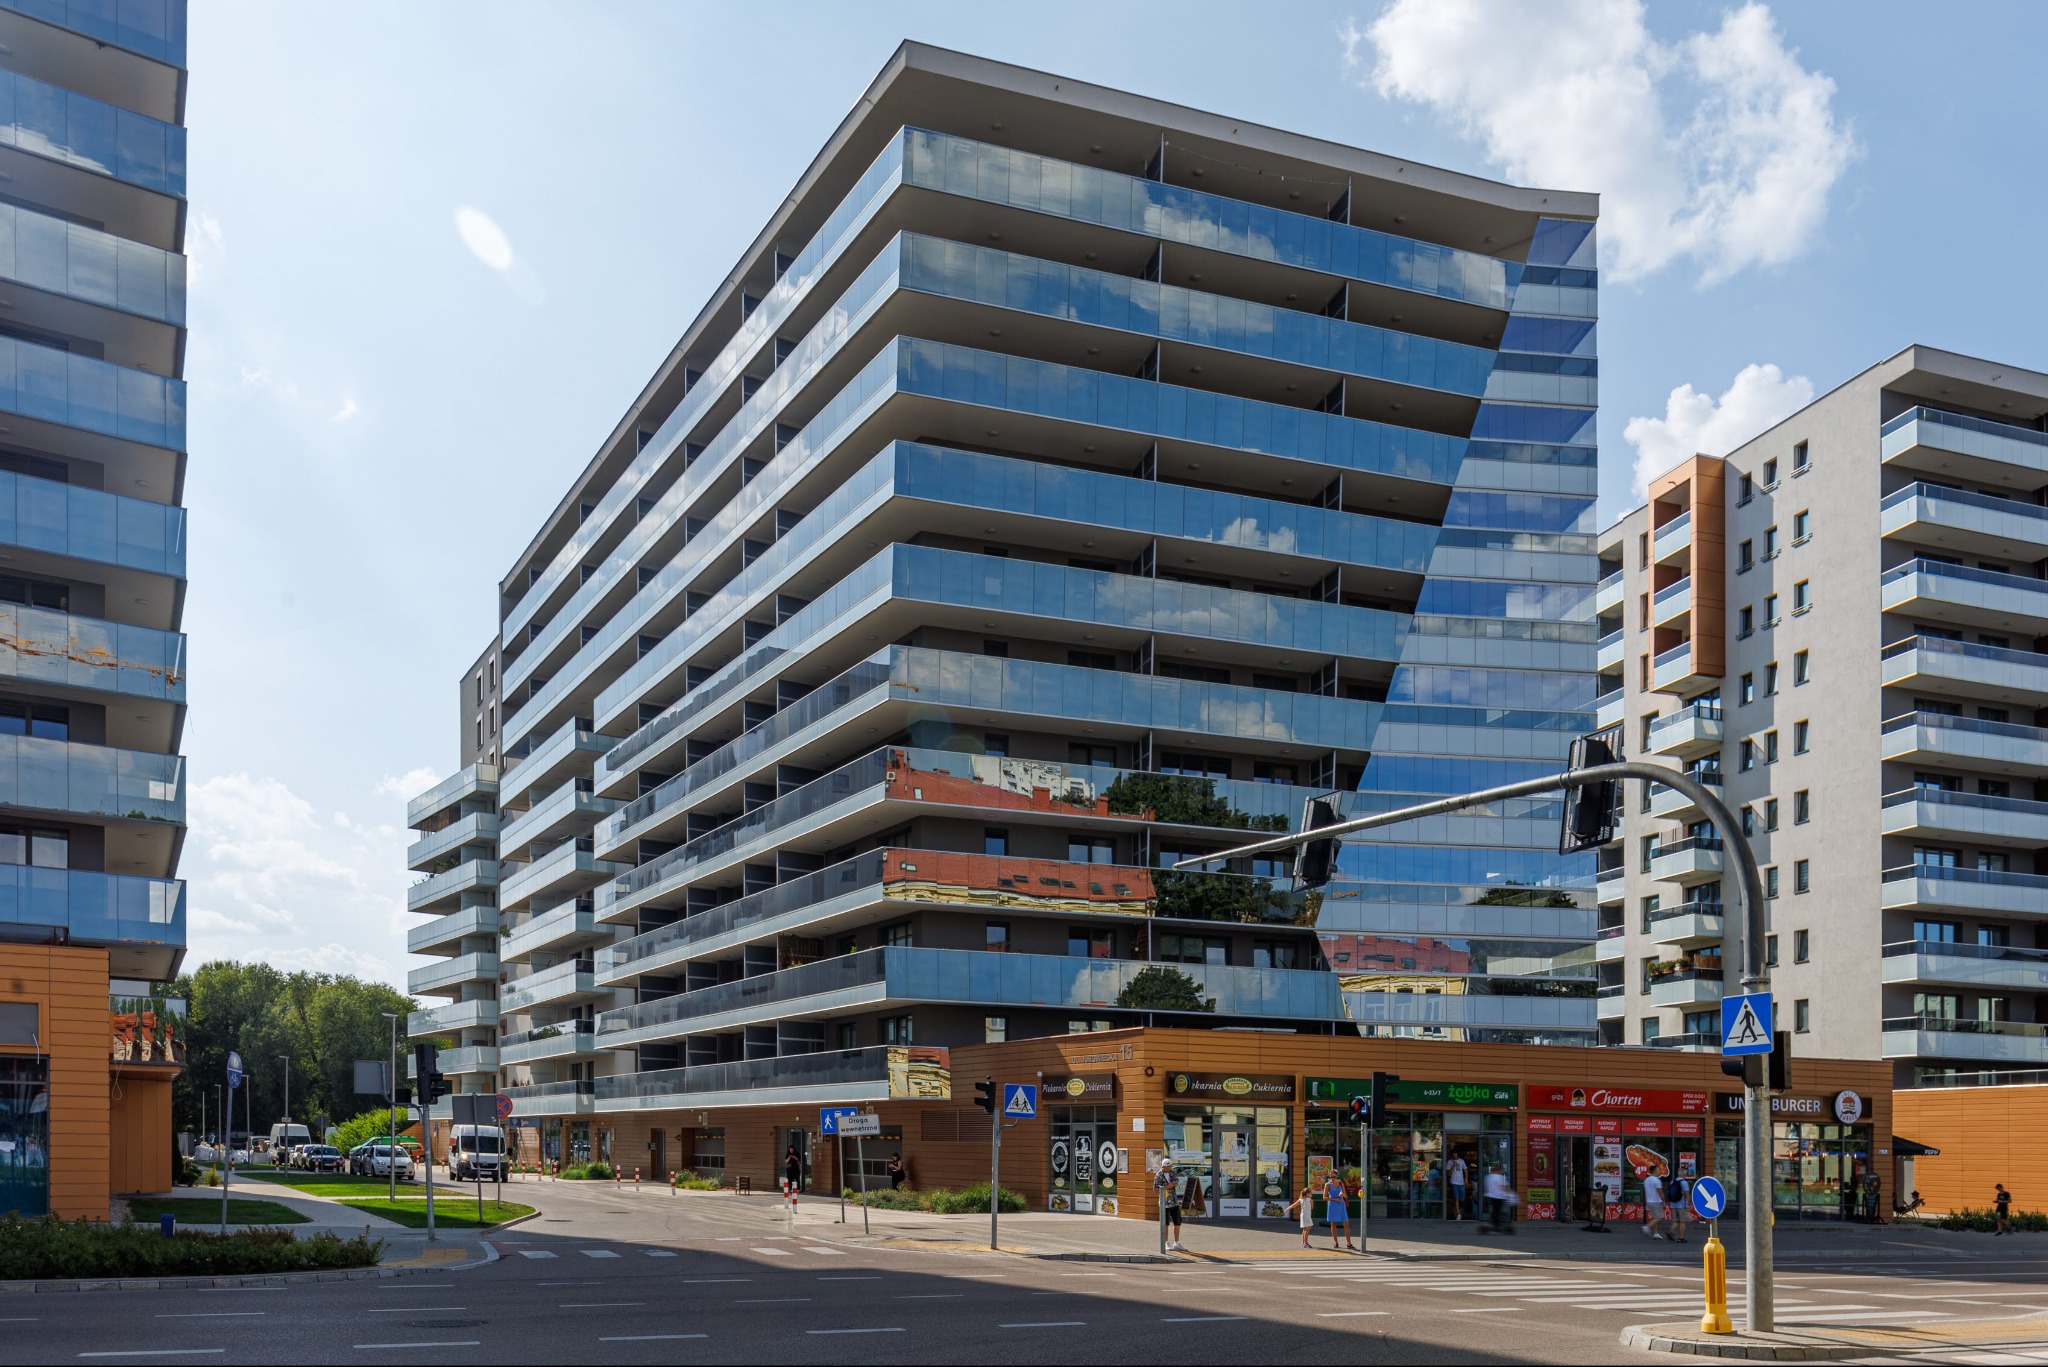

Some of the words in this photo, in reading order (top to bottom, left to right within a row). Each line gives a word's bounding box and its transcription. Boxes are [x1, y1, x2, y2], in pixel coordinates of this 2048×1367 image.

[1082, 1053, 1118, 1063] JUROWIECKA
[1120, 1044, 1133, 1060] 15
[1042, 1084, 1066, 1092] Piekarnia
[1086, 1082, 1111, 1092] Cukiernia
[1253, 1082, 1292, 1092] Cukiernia
[1448, 1085, 1490, 1098] żabka
[1591, 1090, 1642, 1106] Chorten
[1772, 1098, 1820, 1112] BURGER
